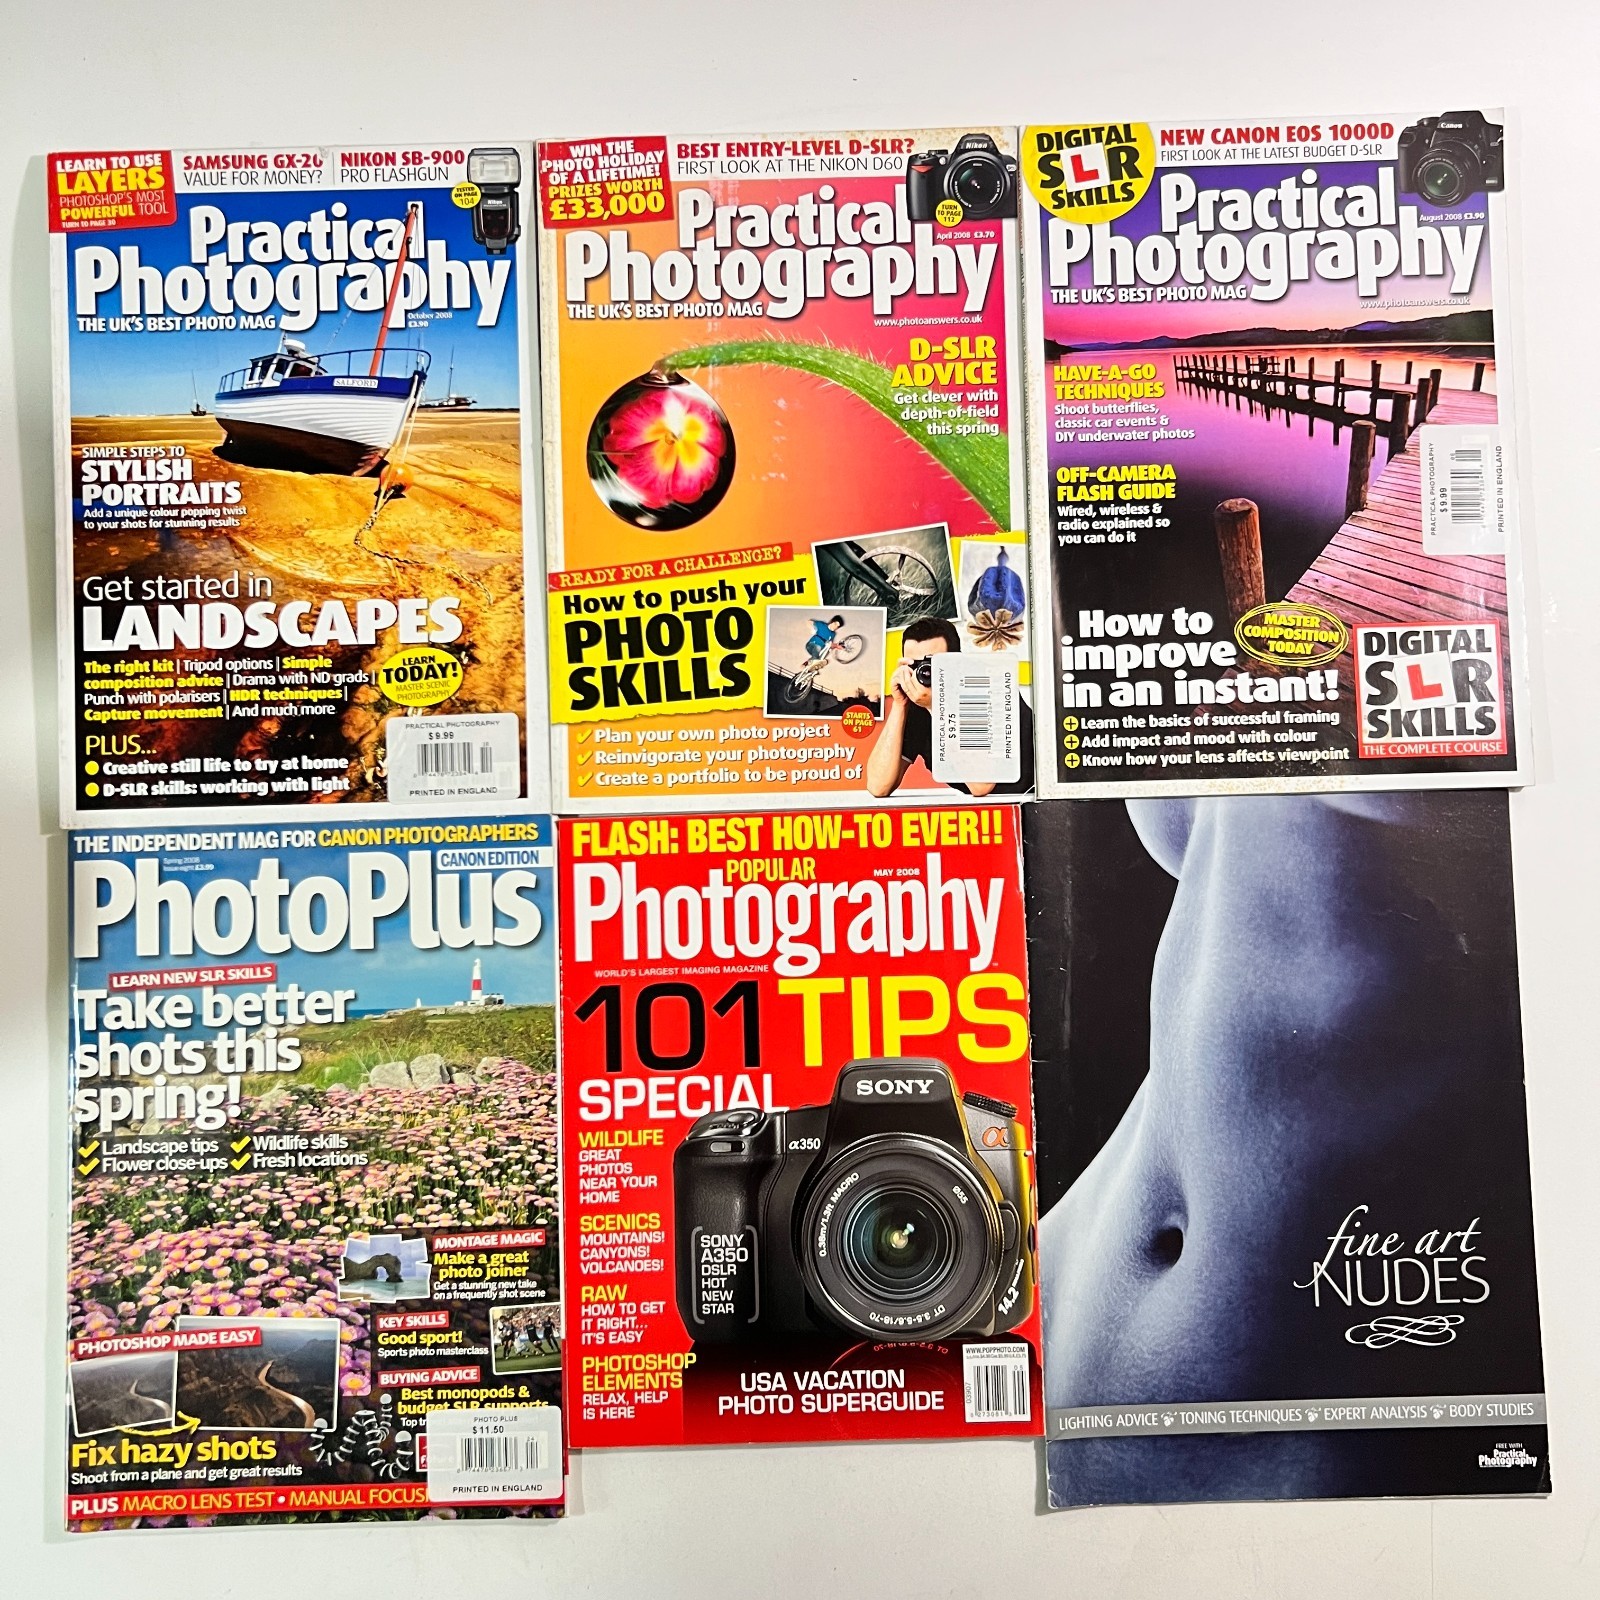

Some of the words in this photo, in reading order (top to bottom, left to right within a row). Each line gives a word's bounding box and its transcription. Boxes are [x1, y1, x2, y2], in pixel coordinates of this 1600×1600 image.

[1036, 124, 1137, 153] DIGITAL
[56, 158, 108, 172] LEARN
[110, 156, 130, 169] TO
[134, 153, 162, 167] USE
[341, 152, 397, 167] NIKON
[402, 150, 465, 165] SB-900
[678, 161, 715, 174] FIRST
[721, 160, 760, 174] LOOK
[765, 160, 783, 172] AT
[788, 158, 815, 172] THE
[820, 157, 868, 171] NIKON
[873, 156, 902, 170] D60
[57, 166, 165, 195] LAYERS
[341, 168, 369, 183] PRO
[375, 166, 449, 182] FLASHGUN
[60, 192, 133, 207] PHOTOSHOP'S
[136, 190, 165, 203] MOST
[460, 197, 475, 205] 104
[1051, 182, 1135, 210] SKILLS
[1161, 167, 1396, 232] Practical
[61, 205, 135, 220] POWERFUL
[138, 203, 169, 215] TOOL
[550, 192, 665, 221] £33,000
[678, 184, 912, 248] Practical
[1419, 213, 1443, 222] August
[190, 201, 424, 263] Practical
[937, 232, 951, 240] April
[1048, 205, 1484, 301] Photography
[565, 224, 998, 319] Photography
[75, 238, 511, 331] Photography
[874, 314, 982, 328] www.photoanswers.co.uk
[910, 336, 997, 361] D-SLR
[891, 362, 997, 387] ADVICE
[1054, 364, 1156, 382] HAVE-A-GO
[1054, 382, 1165, 402] TECHNIQUES
[81, 458, 193, 482] STYLISH
[1056, 464, 1176, 483] OFF-CAMERA
[82, 481, 242, 506] PORTRAITS
[1057, 485, 1114, 501] FLASH
[1118, 483, 1176, 500] GUIDE
[559, 569, 616, 587] READY
[622, 564, 655, 580] FOR
[661, 562, 671, 574] A
[674, 546, 782, 573] CHALLENGE?
[1264, 613, 1320, 628] MASTER
[564, 607, 754, 664] PHOTO
[1244, 625, 1340, 643] COMPOSITION
[1268, 640, 1315, 655] TODAY
[402, 655, 435, 666] LEARN
[383, 662, 458, 684] TODAY!
[568, 653, 751, 711] SKILLS
[846, 712, 871, 720] STARTS
[855, 718, 873, 726] PAGE
[853, 725, 862, 733] 61
[85, 734, 157, 755] PLUS...
[1363, 745, 1386, 755] THE
[1388, 742, 1451, 754] COMPLETE
[1454, 741, 1502, 753] COURSE
[441, 851, 487, 867] CANON
[488, 850, 539, 866] EDITION
[727, 857, 816, 882] POPULAR
[873, 869, 893, 877] MAY
[896, 868, 920, 876] 2008
[74, 850, 542, 959] PhotoPlus
[573, 852, 1004, 977] Photography
[112, 974, 161, 988] LEARN
[163, 971, 197, 984] NEW
[200, 969, 225, 982] SLR
[227, 967, 272, 980] SKILLS
[595, 969, 636, 978] WORLD'S
[639, 968, 679, 976] LARGEST
[682, 967, 720, 975] IMAGING
[723, 965, 769, 973] MAGAZINE
[574, 980, 760, 1073] 101
[778, 973, 1029, 1067] TIPS
[857, 1079, 934, 1095] SONY
[579, 1073, 790, 1121] SPECIAL
[102, 1140, 188, 1156] Landscape
[191, 1139, 219, 1154] tips
[254, 1136, 308, 1150] Wildlife
[311, 1135, 348, 1149] skills
[579, 1129, 664, 1148] WILDLIFE
[102, 1157, 155, 1173] Flower
[156, 1156, 228, 1172] close-ups
[254, 1153, 296, 1168] Fresh
[298, 1150, 368, 1167] locations
[832, 1172, 860, 1204] MACRO
[580, 1213, 661, 1231] SCENICS
[434, 1236, 498, 1249] MONTAGE
[500, 1232, 543, 1245] MAGIC
[701, 1234, 744, 1248] SONY
[1293, 1204, 1405, 1288] fine
[1415, 1217, 1482, 1256] art
[701, 1248, 748, 1263] A350
[701, 1264, 737, 1276] DSLR
[1313, 1256, 1490, 1307] NUDES
[581, 1284, 627, 1302] RAW
[998, 1287, 1020, 1315] 14.2
[934, 1305, 946, 1317] DT
[379, 1317, 405, 1328] KEY
[407, 1314, 446, 1326] SKILLS
[378, 1348, 407, 1358] Sports
[409, 1347, 435, 1357] photo
[437, 1346, 489, 1356] masterclass
[582, 1353, 697, 1373] PHOTOSHOP
[380, 1372, 429, 1385] BUYING
[432, 1369, 478, 1382] ADVICE
[583, 1372, 683, 1391] ELEMENTS
[740, 1372, 788, 1392] USA
[794, 1369, 905, 1390] VACATION
[718, 1395, 794, 1415] PHOTO
[801, 1391, 944, 1413] SUPERGUIDE
[1059, 1415, 1112, 1430] LIGHTING
[1116, 1413, 1158, 1427] ADVICE
[1180, 1411, 1226, 1424] TONING
[1229, 1409, 1301, 1424] TECHNIQUES
[1324, 1407, 1367, 1420] EXPERT
[1370, 1406, 1427, 1419] ANALYSIS
[1450, 1404, 1483, 1417] BODY
[1486, 1403, 1534, 1416] STUDIES
[473, 1426, 477, 1434] $
[479, 1426, 504, 1434] 11.50
[1479, 1455, 1537, 1467] Photography
[1493, 1449, 1526, 1458] Practical
[453, 1486, 488, 1494] PRINTED
[502, 1484, 542, 1492] ENGLAND
